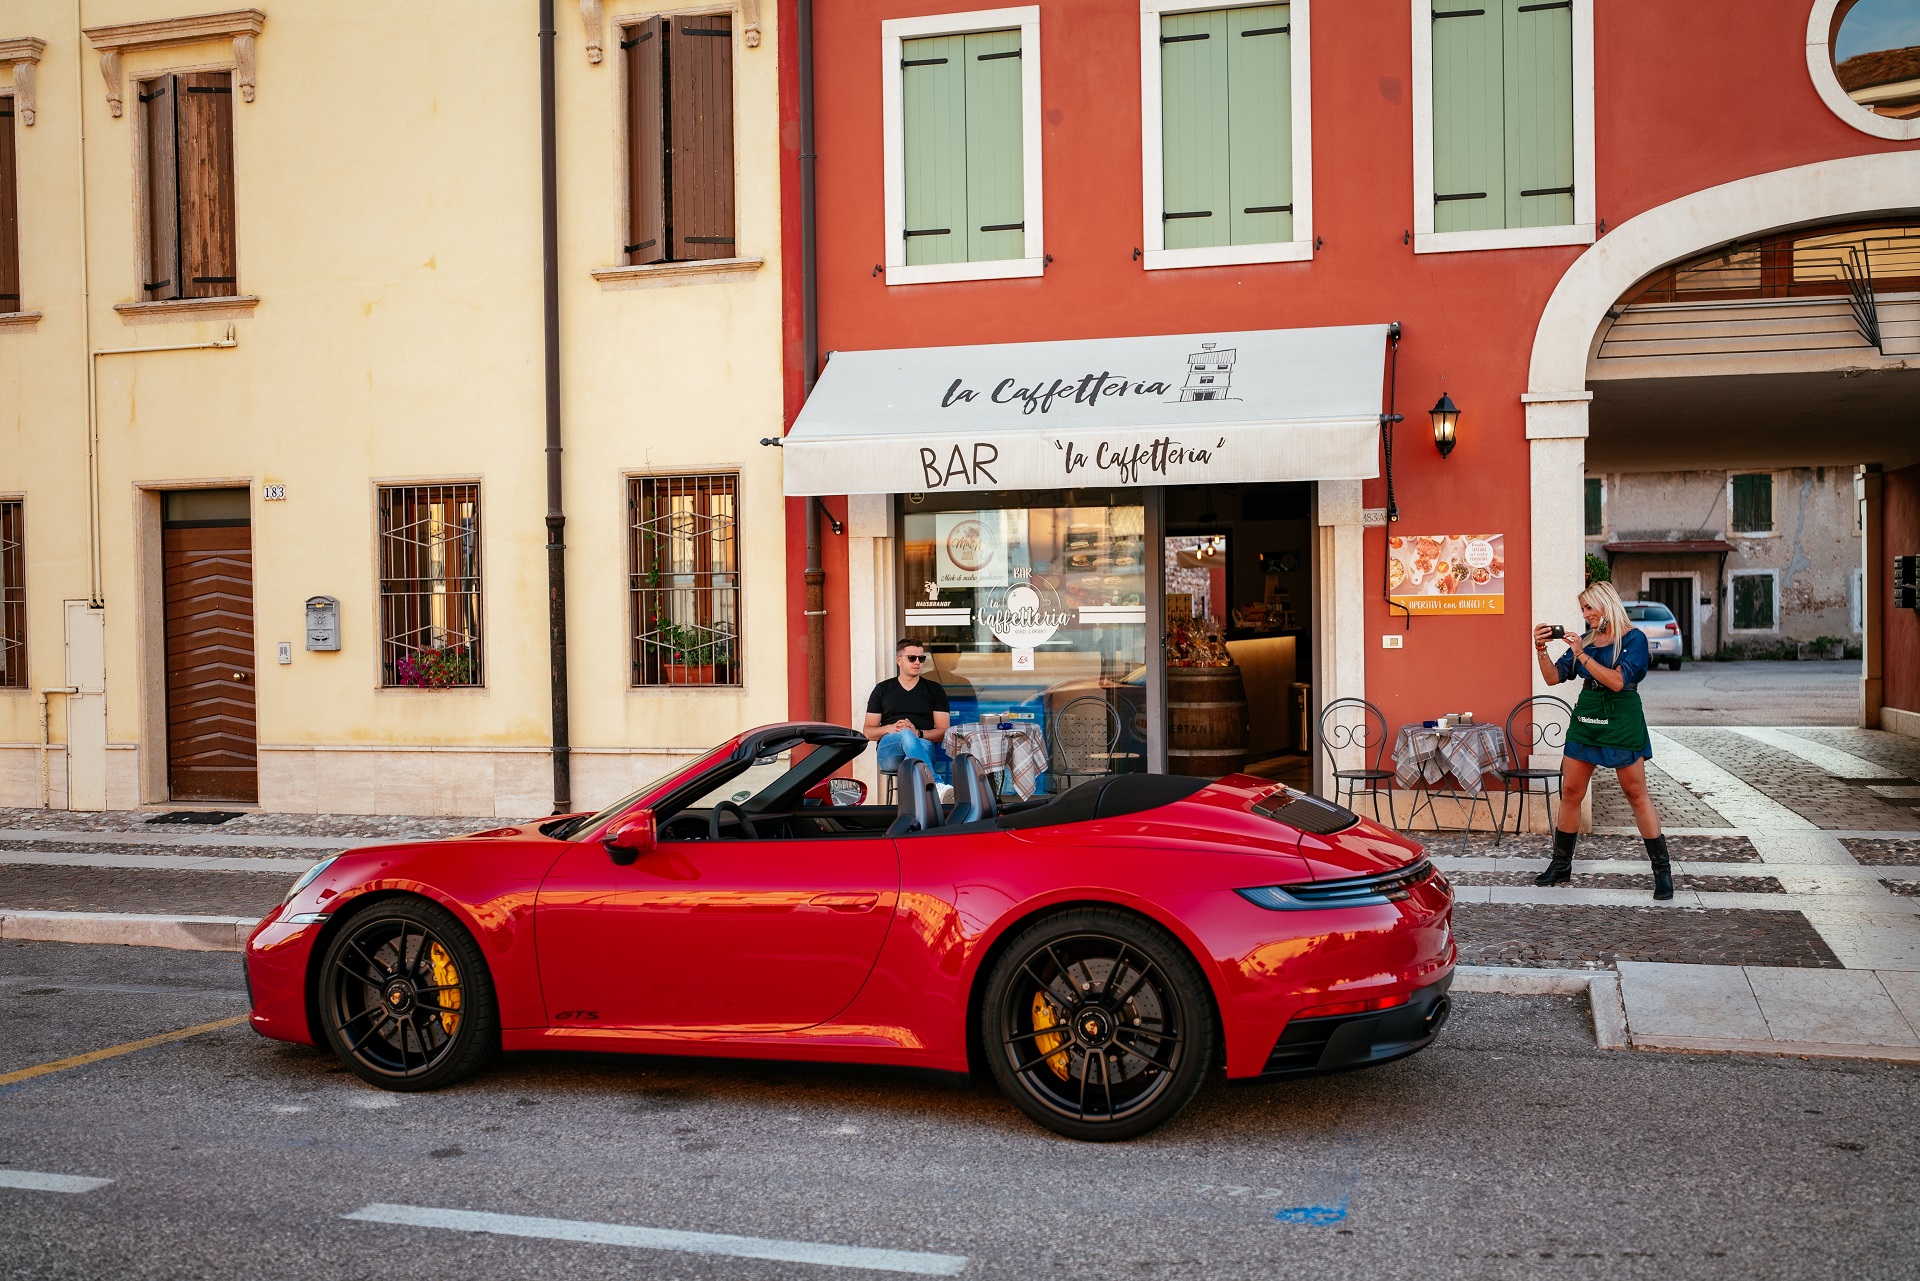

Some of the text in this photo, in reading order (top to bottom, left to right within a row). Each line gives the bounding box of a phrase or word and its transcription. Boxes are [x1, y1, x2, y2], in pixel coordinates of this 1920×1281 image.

[941, 370, 1172, 415] la Caffetteria
[920, 442, 998, 489] BAR
[264, 486, 285, 498] 183
[1013, 566, 1033, 579] BAR
[977, 606, 1070, 634] Caffetteria
[1168, 724, 1214, 735] ERTANI
[555, 1010, 600, 1020] GTS
